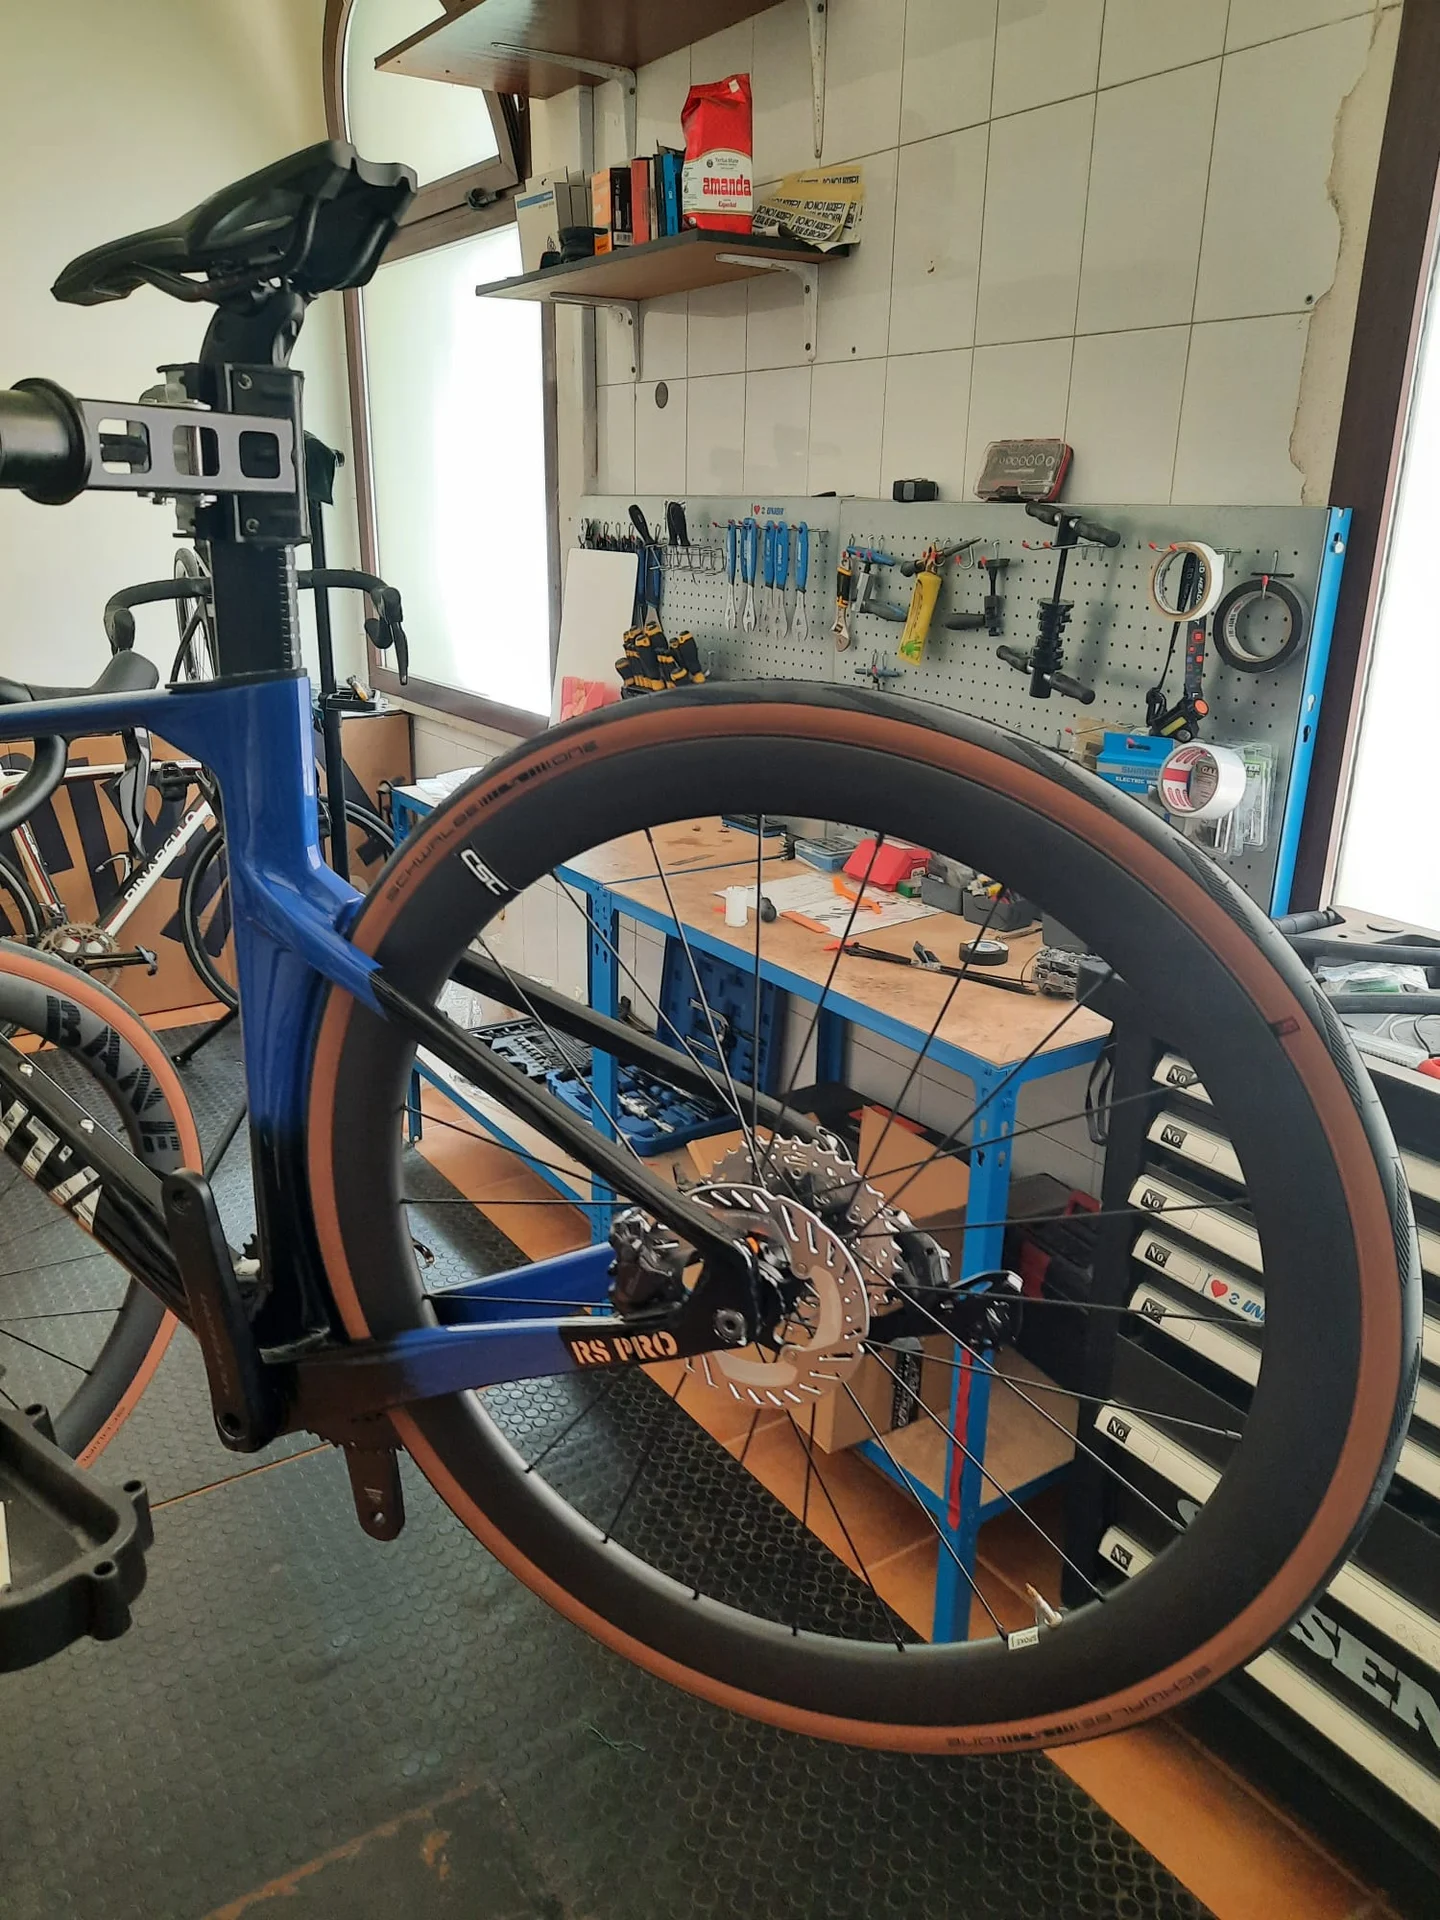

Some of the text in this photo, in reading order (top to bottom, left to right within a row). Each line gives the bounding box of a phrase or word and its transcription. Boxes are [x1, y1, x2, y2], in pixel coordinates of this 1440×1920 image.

[702, 174, 752, 196] amanda
[1121, 767, 1160, 777] SHIMAN
[123, 810, 198, 902] PINARELLO
[571, 1330, 678, 1364] RS PRO
